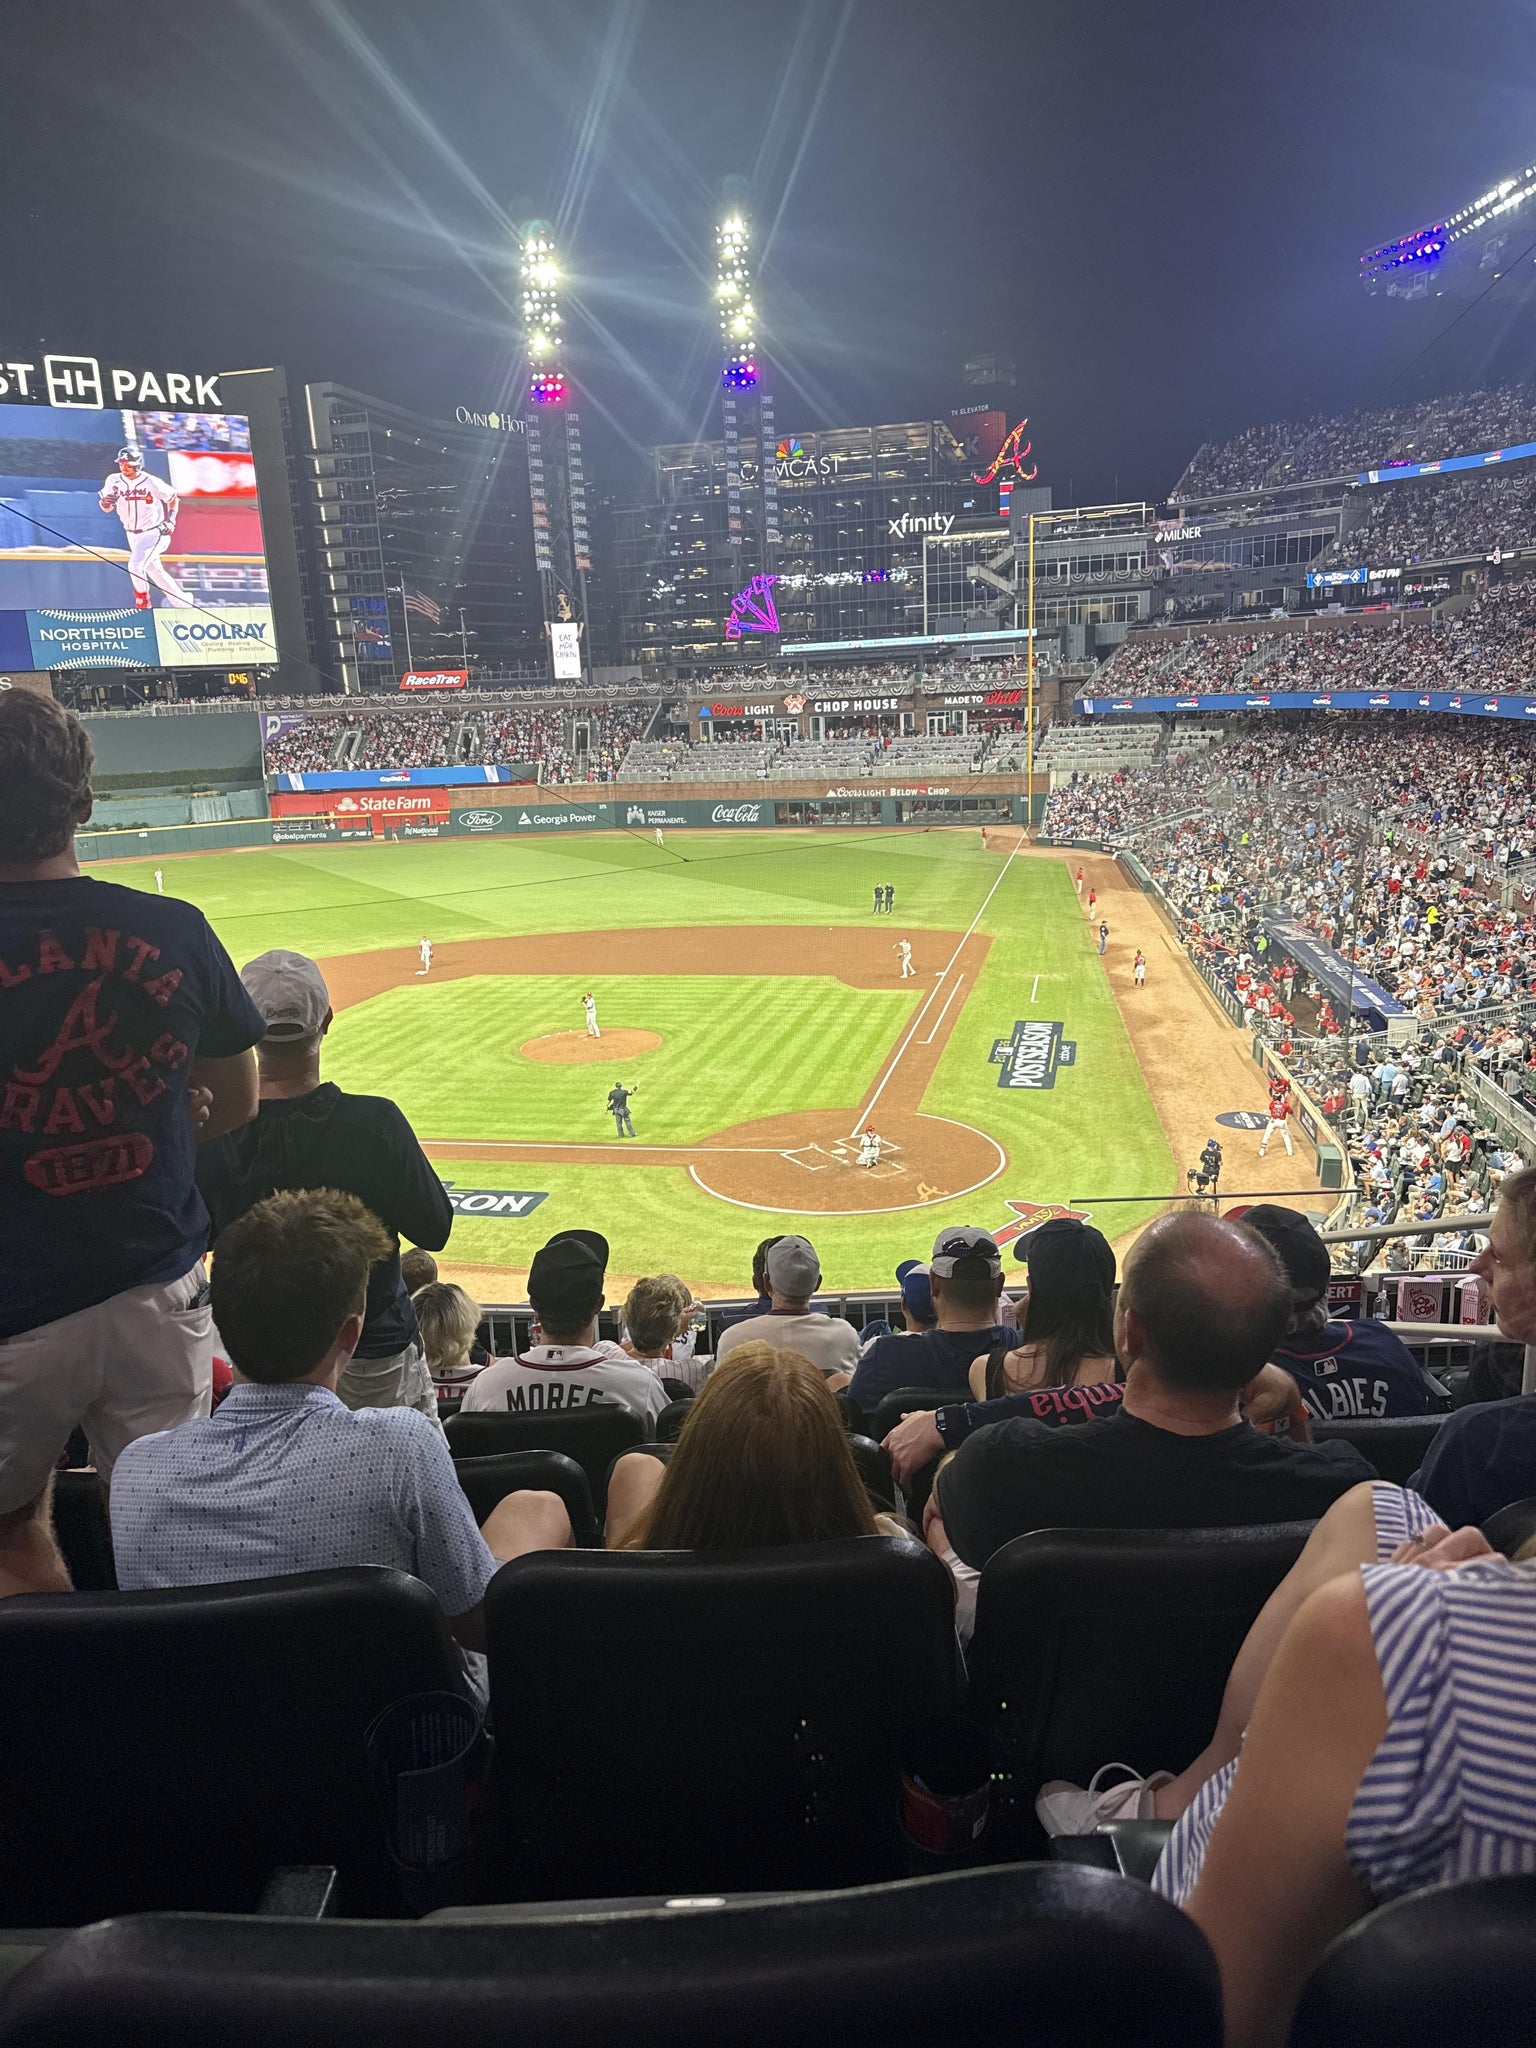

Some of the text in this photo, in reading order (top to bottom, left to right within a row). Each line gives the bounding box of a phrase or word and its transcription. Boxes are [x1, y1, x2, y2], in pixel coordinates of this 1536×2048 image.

[112, 369, 222, 406] PARK
[960, 403, 989, 415] ELEVATOR
[888, 511, 956, 539] xfinity
[1163, 526, 1202, 542] MILNER
[40, 626, 146, 641] NORTHSIDE
[173, 623, 267, 641] COOLRAY
[559, 633, 572, 642] EAT
[61, 641, 129, 651] HOSPITAL
[405, 673, 462, 686] RaceTrac
[944, 689, 1024, 706] MADE TO Chill
[711, 703, 775, 717] Coors LIGHT
[814, 699, 898, 713] CHOP HOUSE
[836, 786, 950, 798] Coors LIGHT BELOW CHOP
[466, 812, 495, 826] Ford
[533, 813, 597, 826] Georgia Power
[1009, 1022, 1054, 1088] POSTSEASON
[1412, 1296, 1431, 1306] POP
[1414, 1303, 1436, 1316] CORN
